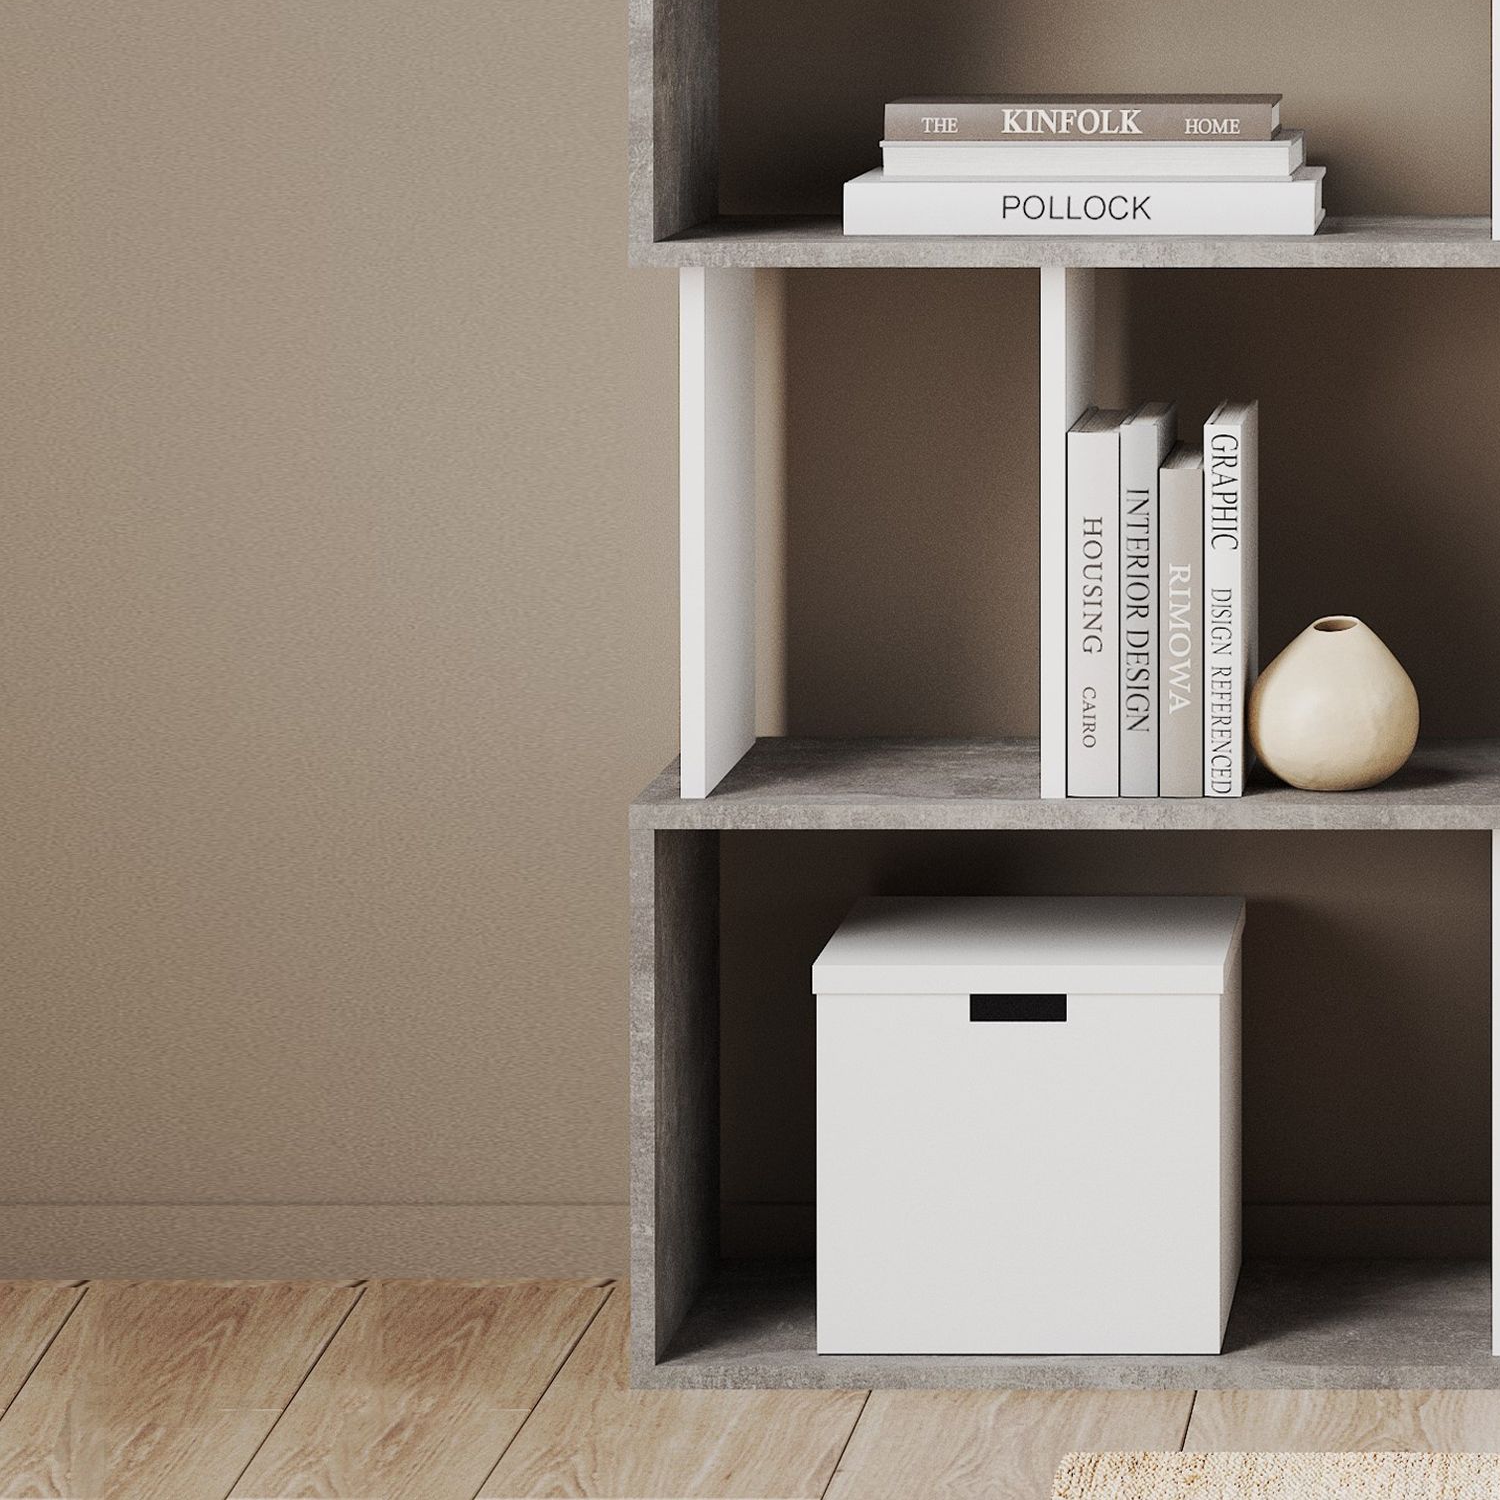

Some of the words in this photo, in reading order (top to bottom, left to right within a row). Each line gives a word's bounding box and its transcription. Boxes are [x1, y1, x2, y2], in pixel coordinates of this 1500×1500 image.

[921, 117, 958, 134] THE
[1001, 108, 1143, 135] KINFOLK
[1184, 118, 1241, 135] HOME
[1002, 194, 1152, 221] POLLOCK
[1210, 432, 1239, 551] GRAPHIC
[1082, 516, 1103, 655] HOUSING
[1125, 488, 1150, 620] INTERIOR
[1168, 563, 1192, 715] RIMOWA
[1210, 587, 1233, 657] DISIGN
[1082, 686, 1097, 749] CAIRO
[1125, 631, 1150, 733] DESIGN
[1210, 665, 1233, 796] REFERENCED
